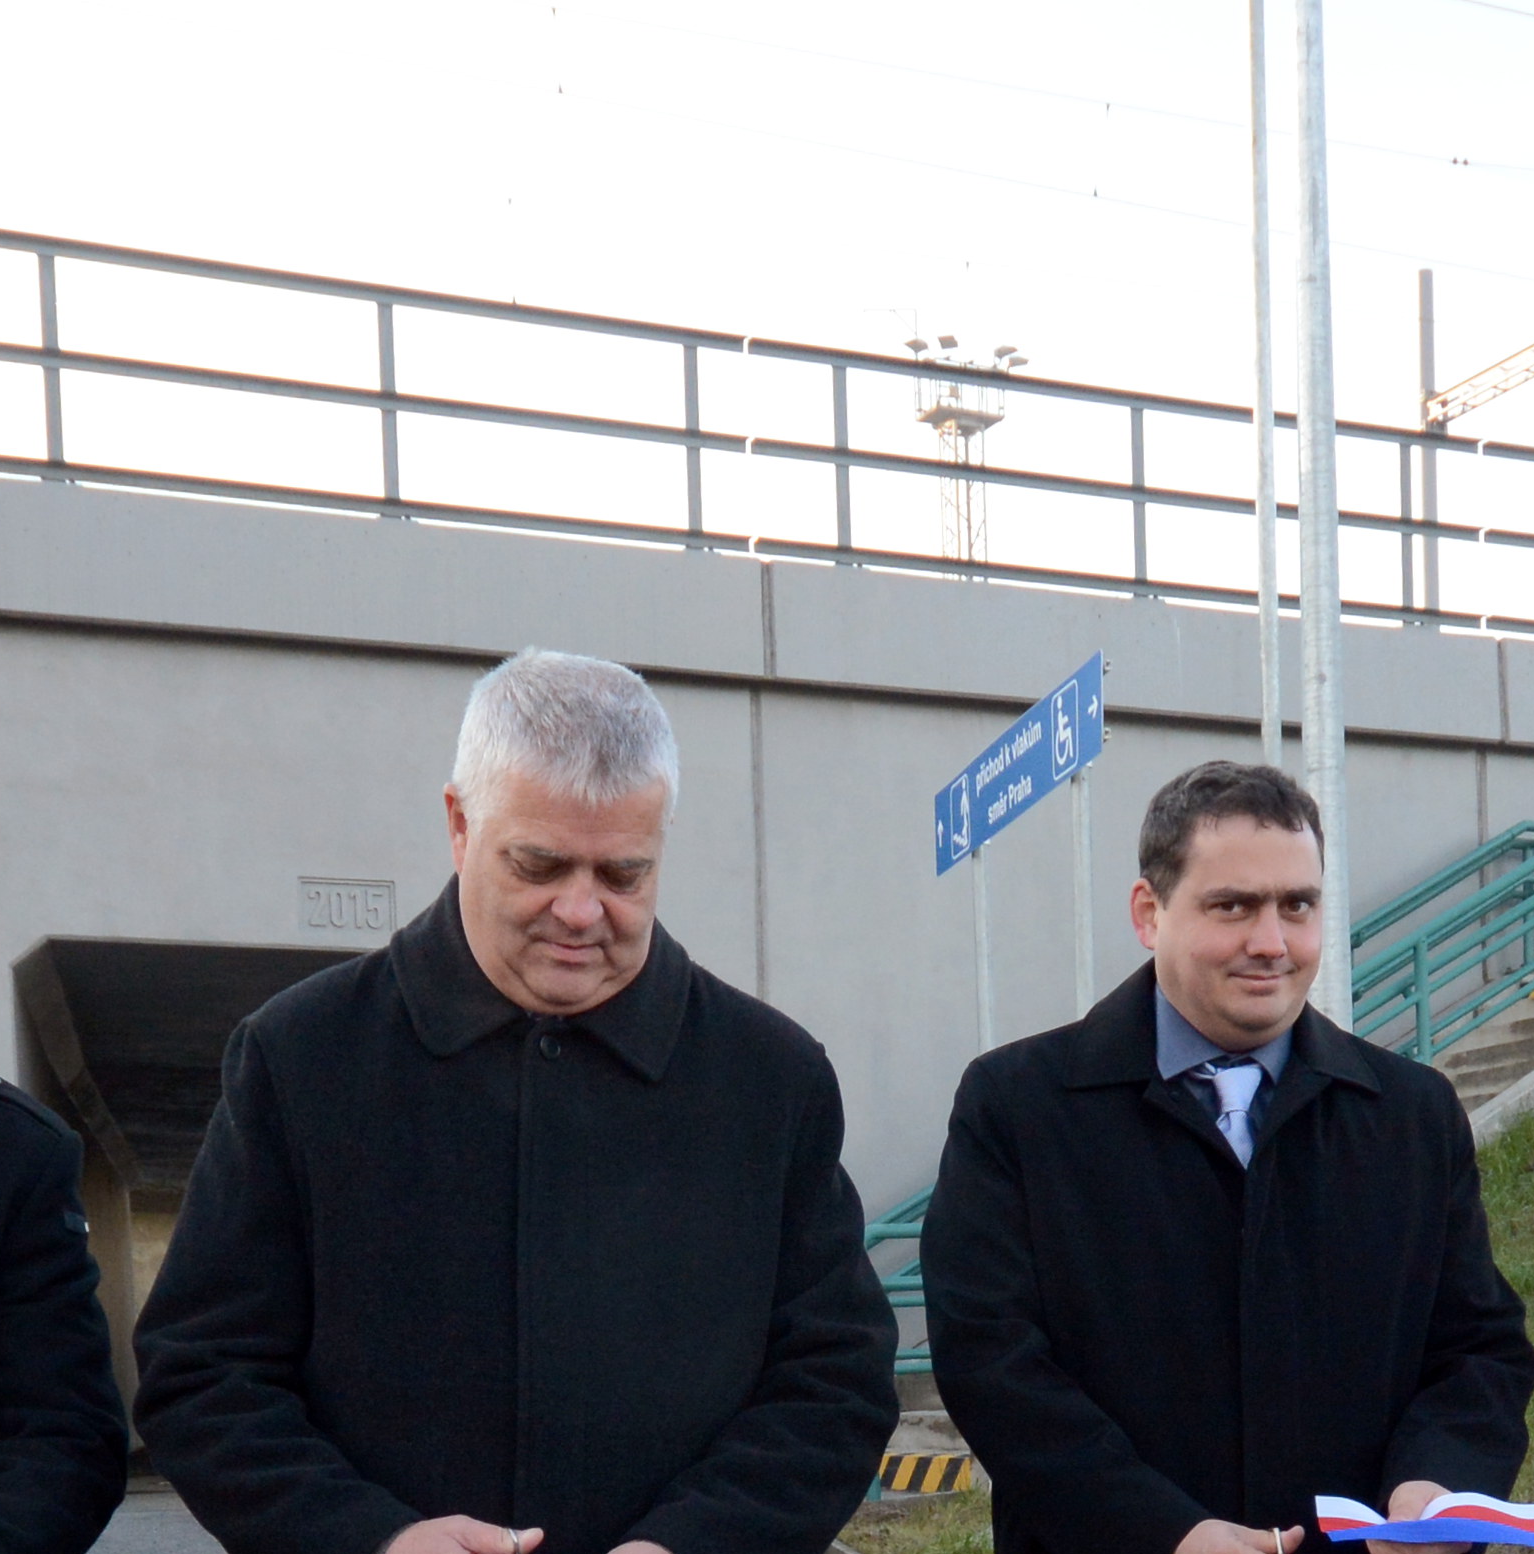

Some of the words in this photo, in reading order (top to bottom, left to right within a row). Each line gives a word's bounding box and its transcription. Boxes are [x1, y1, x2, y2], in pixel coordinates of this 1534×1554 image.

[1004, 743, 1011, 767] k
[988, 787, 1007, 825] směr
[1008, 774, 1032, 809] Praha
[307, 888, 385, 930] 2015
